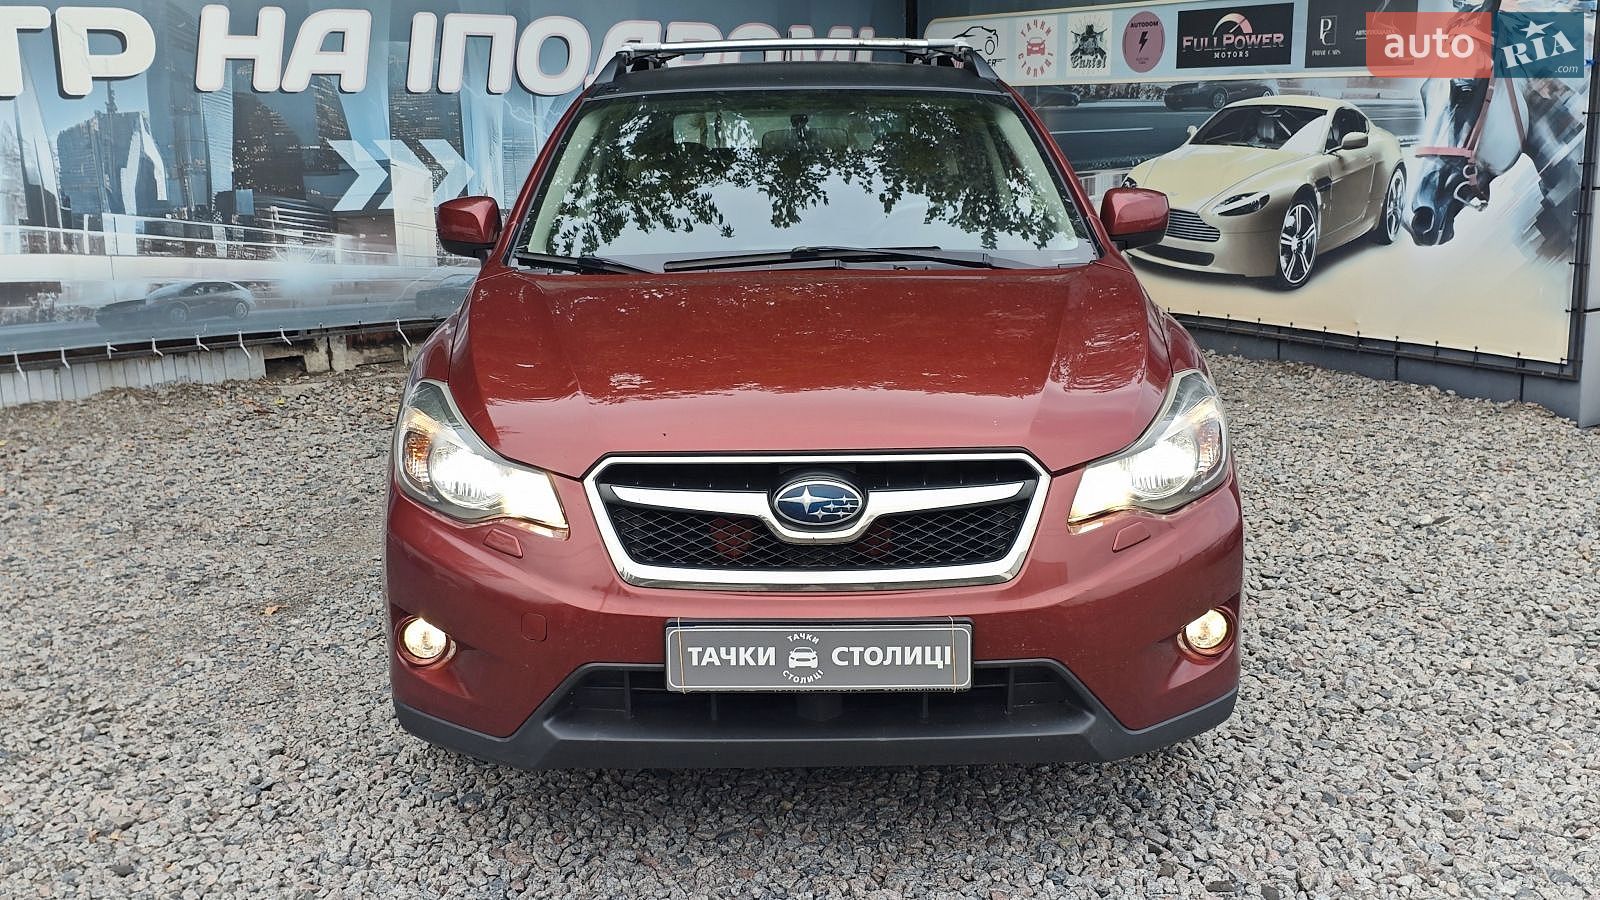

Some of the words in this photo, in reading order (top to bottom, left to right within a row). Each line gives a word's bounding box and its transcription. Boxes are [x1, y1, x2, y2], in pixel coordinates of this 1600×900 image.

[1020, 19, 1052, 37] ТАЧКИ
[1130, 20, 1159, 28] AUTODOM
[195, 5, 372, 92] НА
[1214, 50, 1250, 59] MOTORS
[786, 632, 820, 645] ТАЧКИ
[687, 646, 776, 666] ТАЧКИ
[831, 645, 951, 669] СТОЛИЦІ
[782, 669, 824, 684] СТОЛИЦІ
